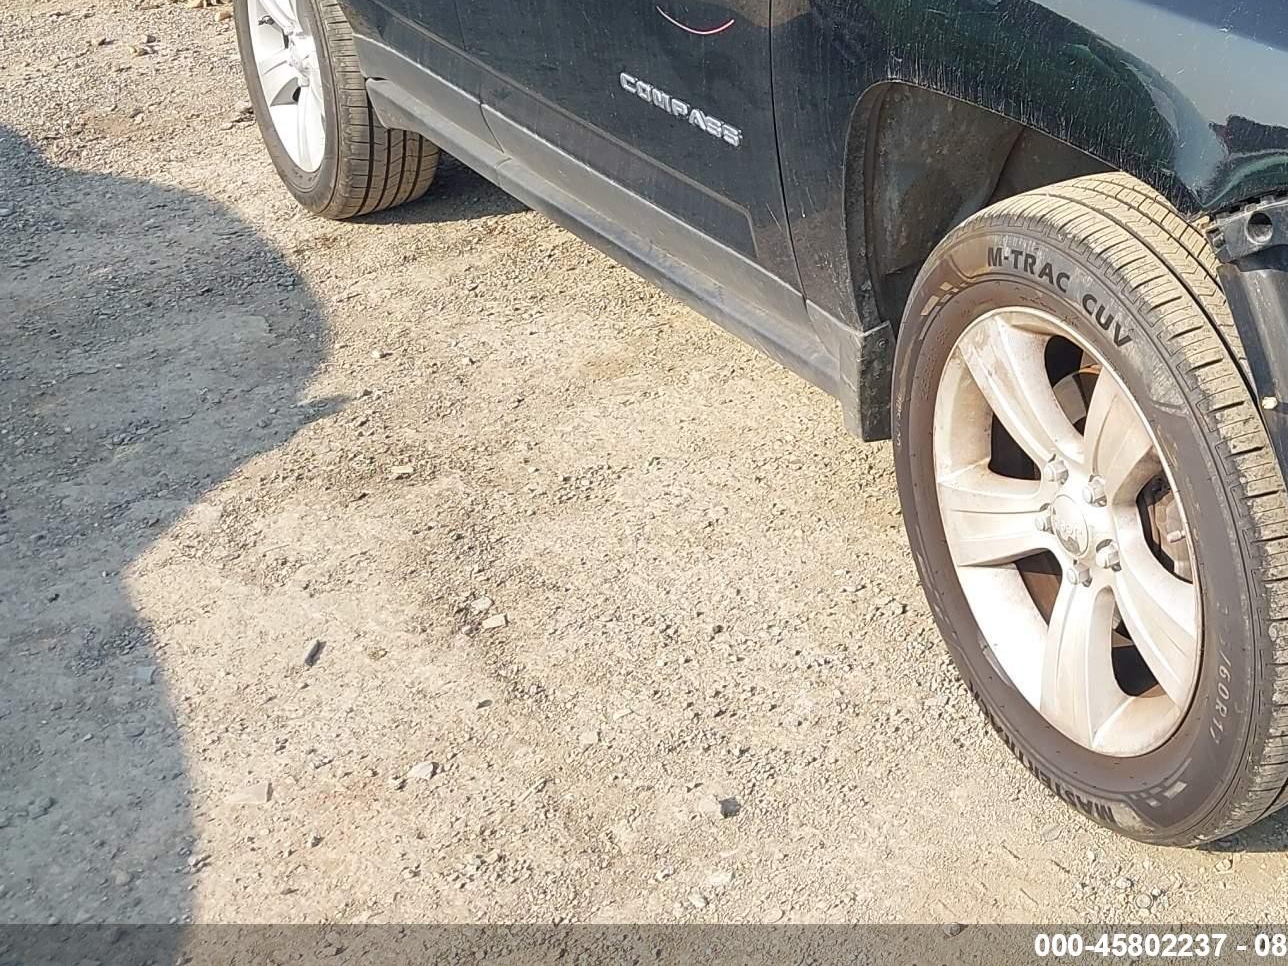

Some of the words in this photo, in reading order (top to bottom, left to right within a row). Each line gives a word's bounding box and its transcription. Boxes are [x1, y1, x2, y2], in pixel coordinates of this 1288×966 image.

[619, 72, 743, 147] COMPASS
[988, 247, 1070, 293] M-TRAC
[1082, 293, 1132, 348] CUV
